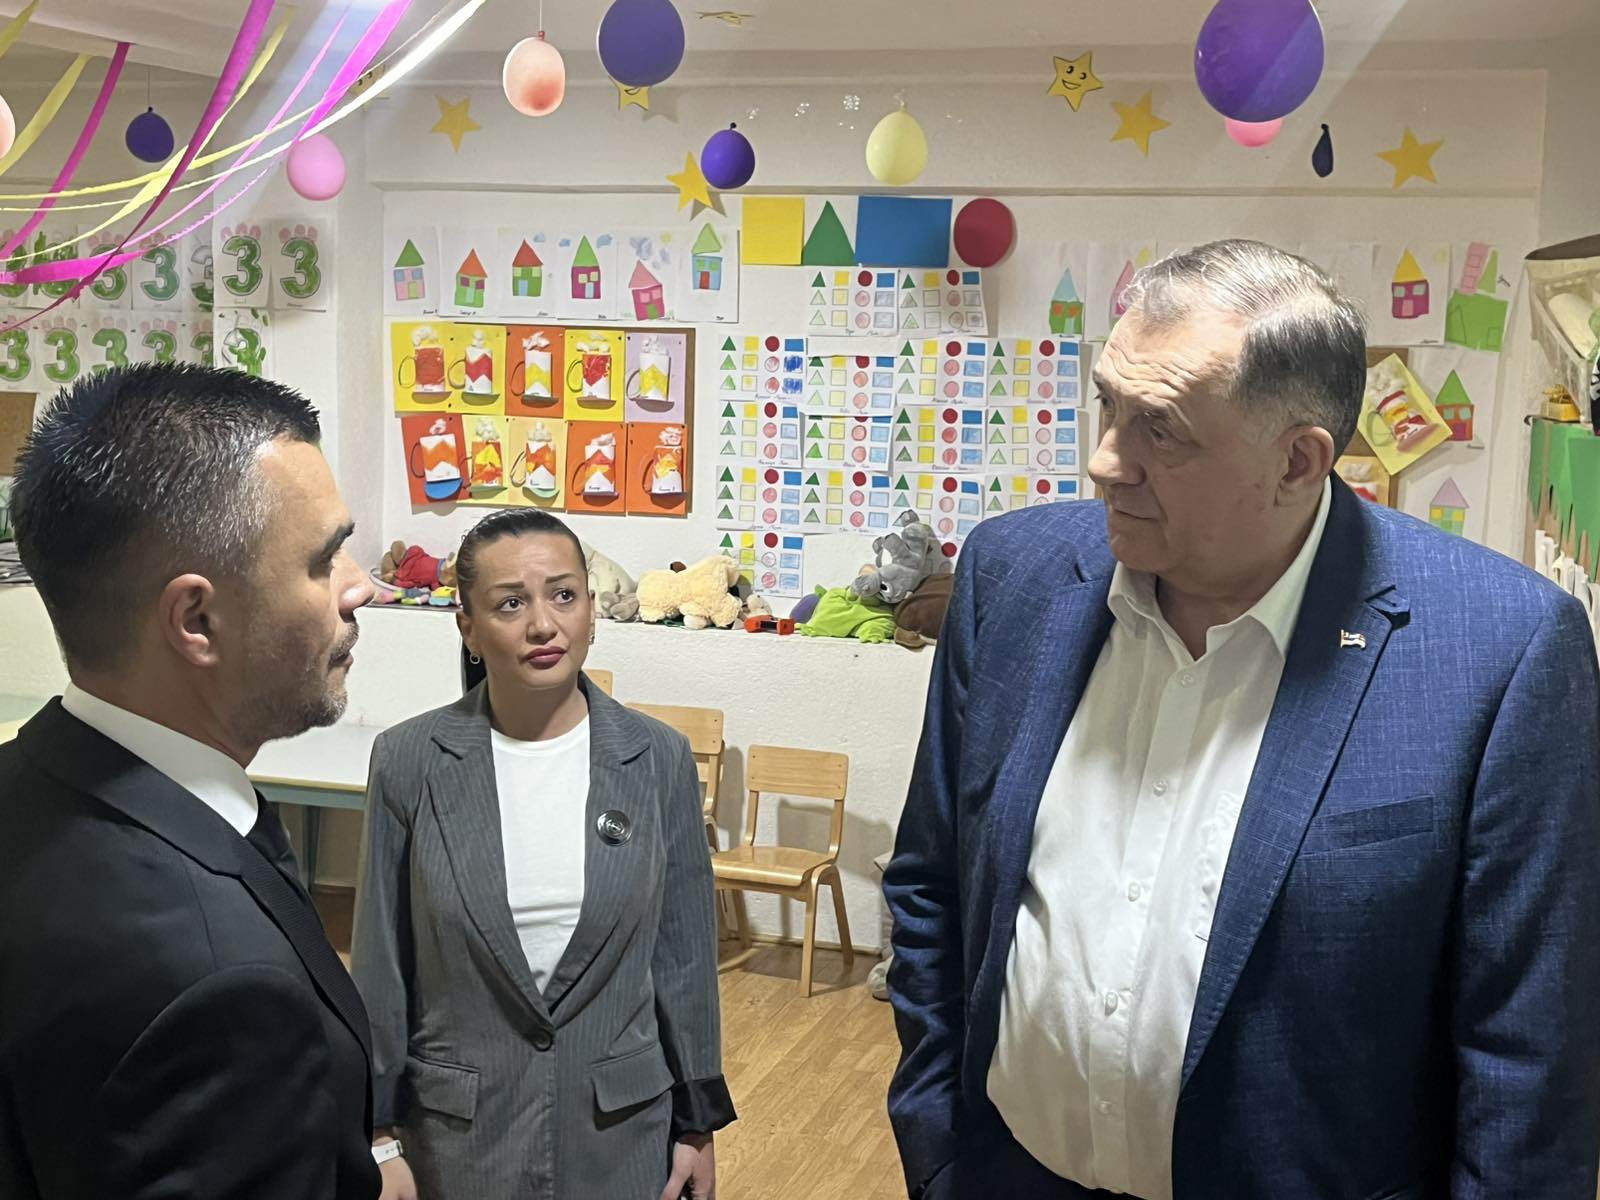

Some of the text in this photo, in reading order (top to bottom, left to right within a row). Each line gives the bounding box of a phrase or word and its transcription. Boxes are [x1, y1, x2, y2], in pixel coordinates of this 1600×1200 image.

[140, 245, 181, 300] 3
[222, 235, 262, 296] 3
[280, 236, 322, 299] 3
[0, 329, 32, 381] 3
[43, 329, 81, 382] 3
